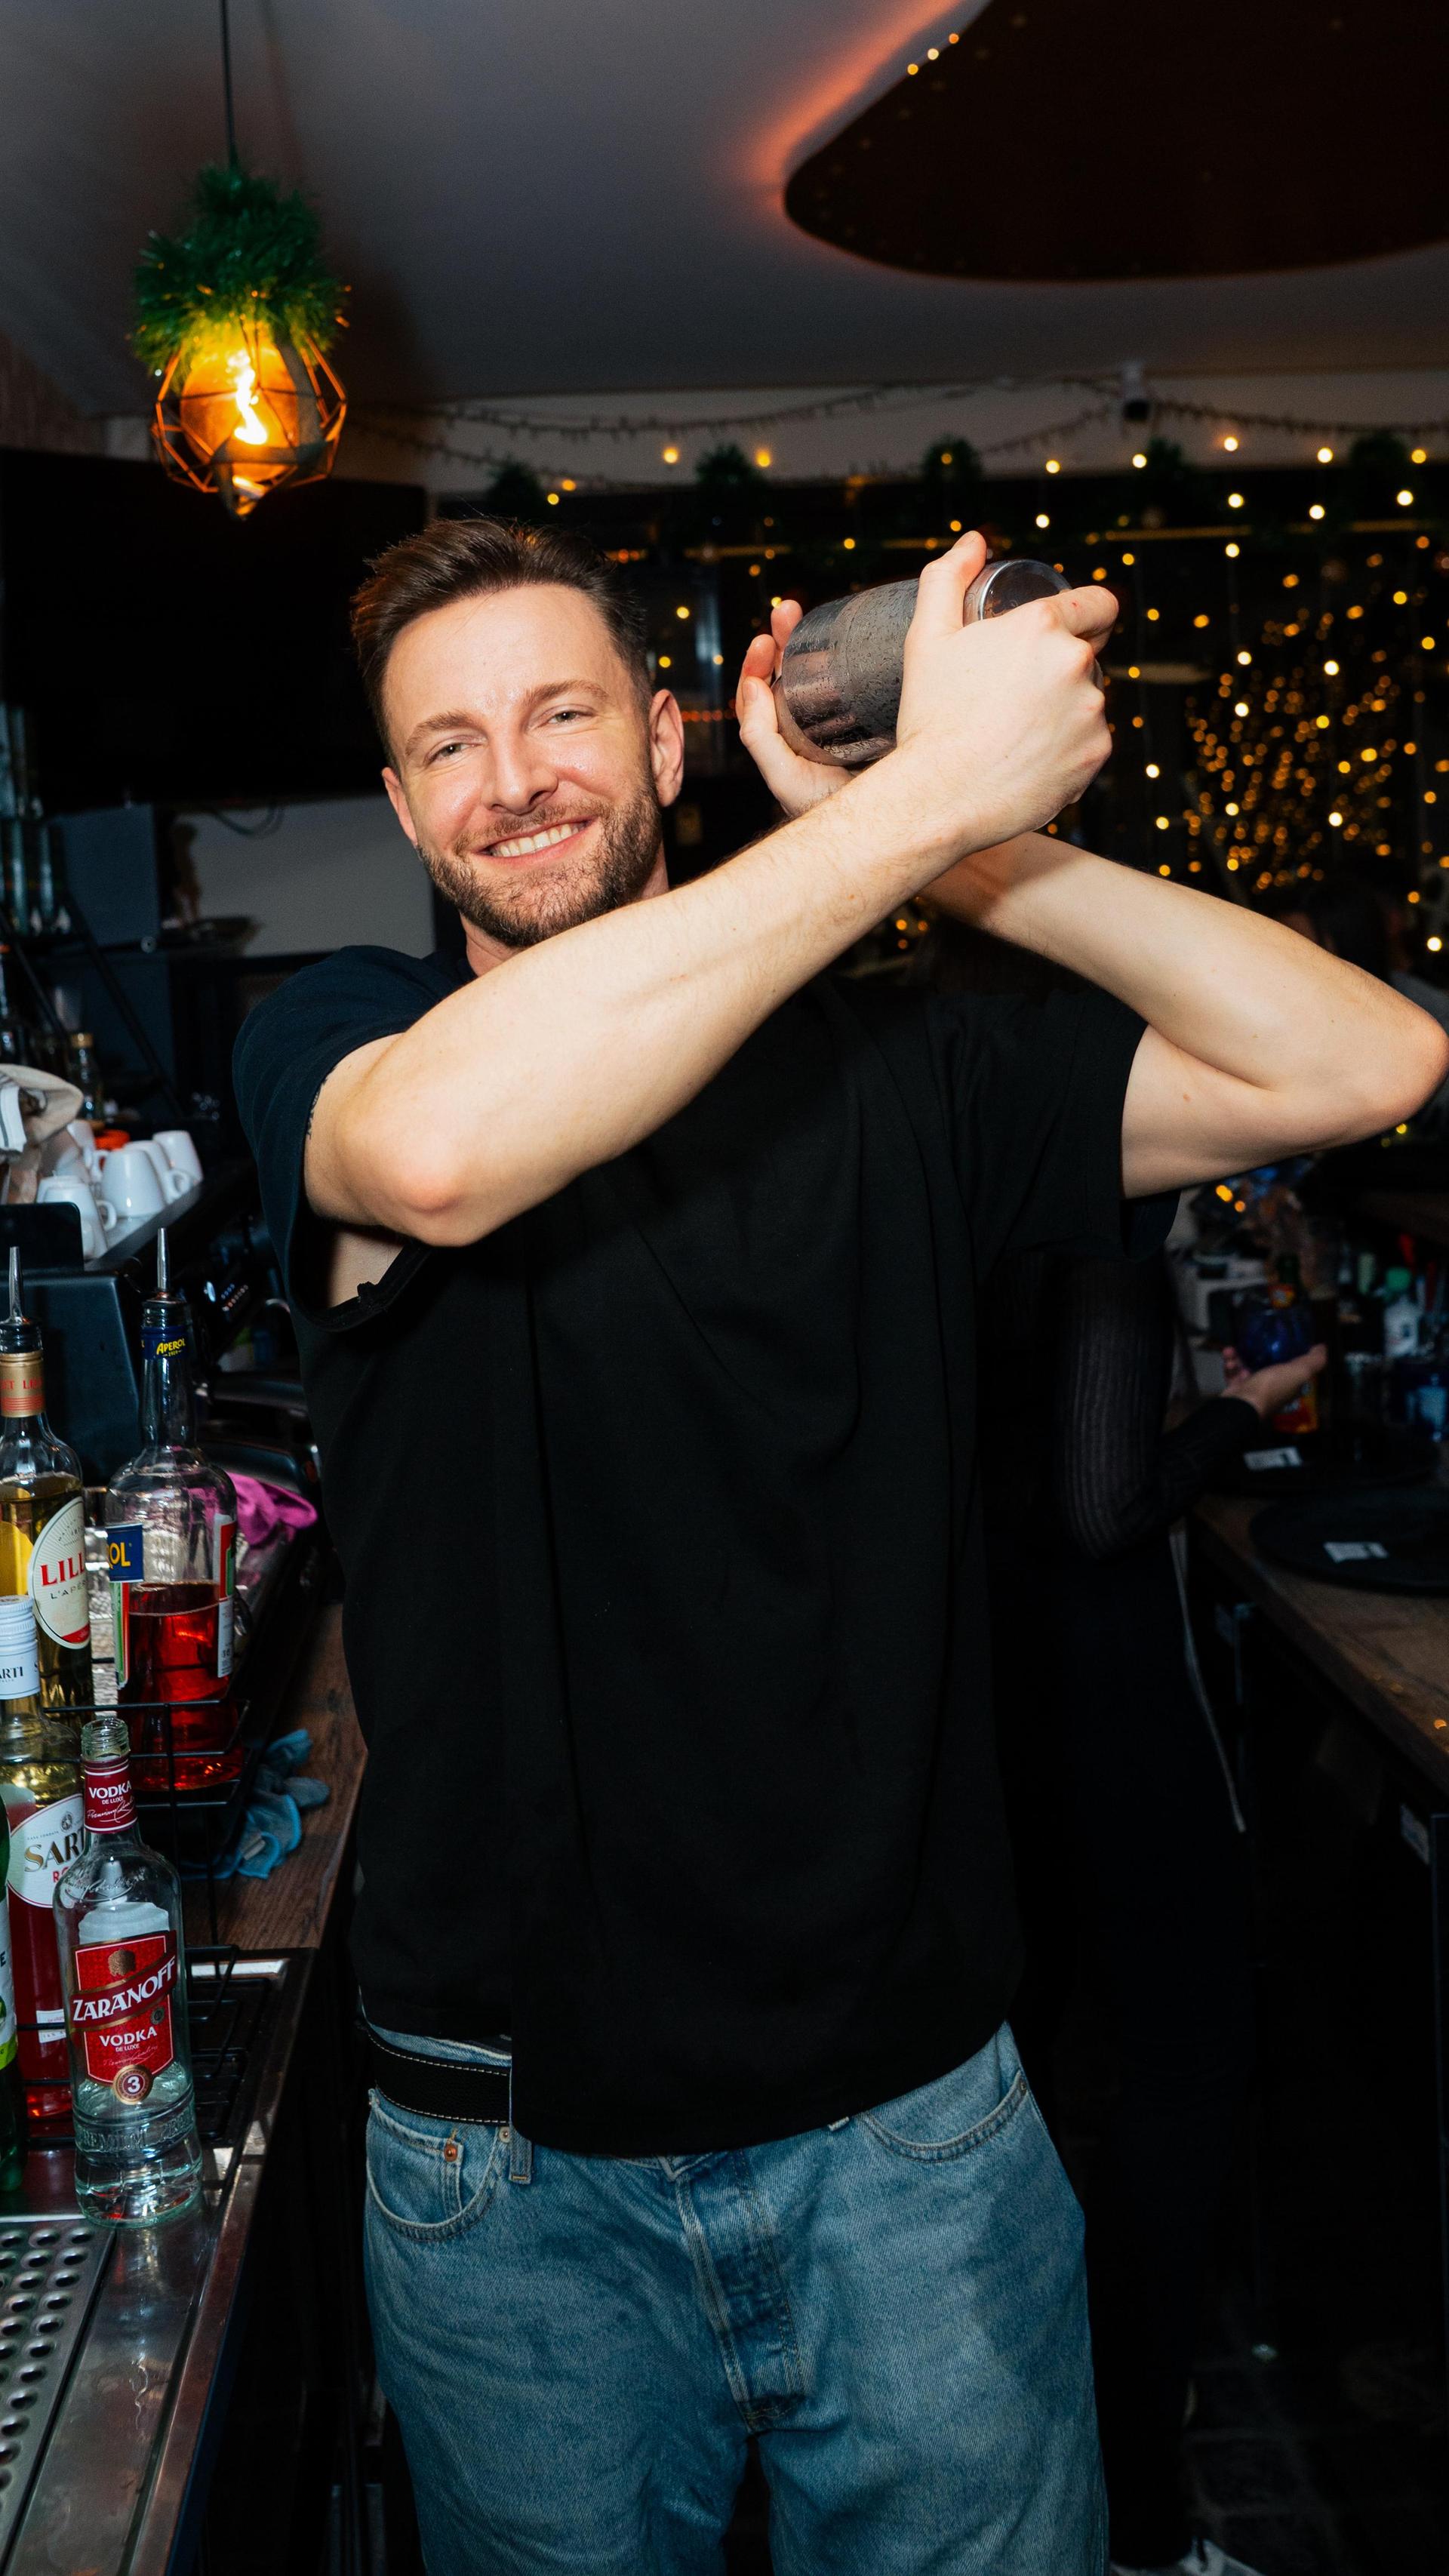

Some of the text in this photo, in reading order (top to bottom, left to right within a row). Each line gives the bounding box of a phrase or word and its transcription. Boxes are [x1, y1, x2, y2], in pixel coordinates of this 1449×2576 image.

[156, 1338, 186, 1355] APEROL
[106, 1542, 131, 1569] OL
[88, 1780, 131, 1799] VODKA
[73, 1955, 175, 2021] ZARANOFF
[99, 2027, 157, 2047] VODKA
[128, 2076, 140, 2093] 3
